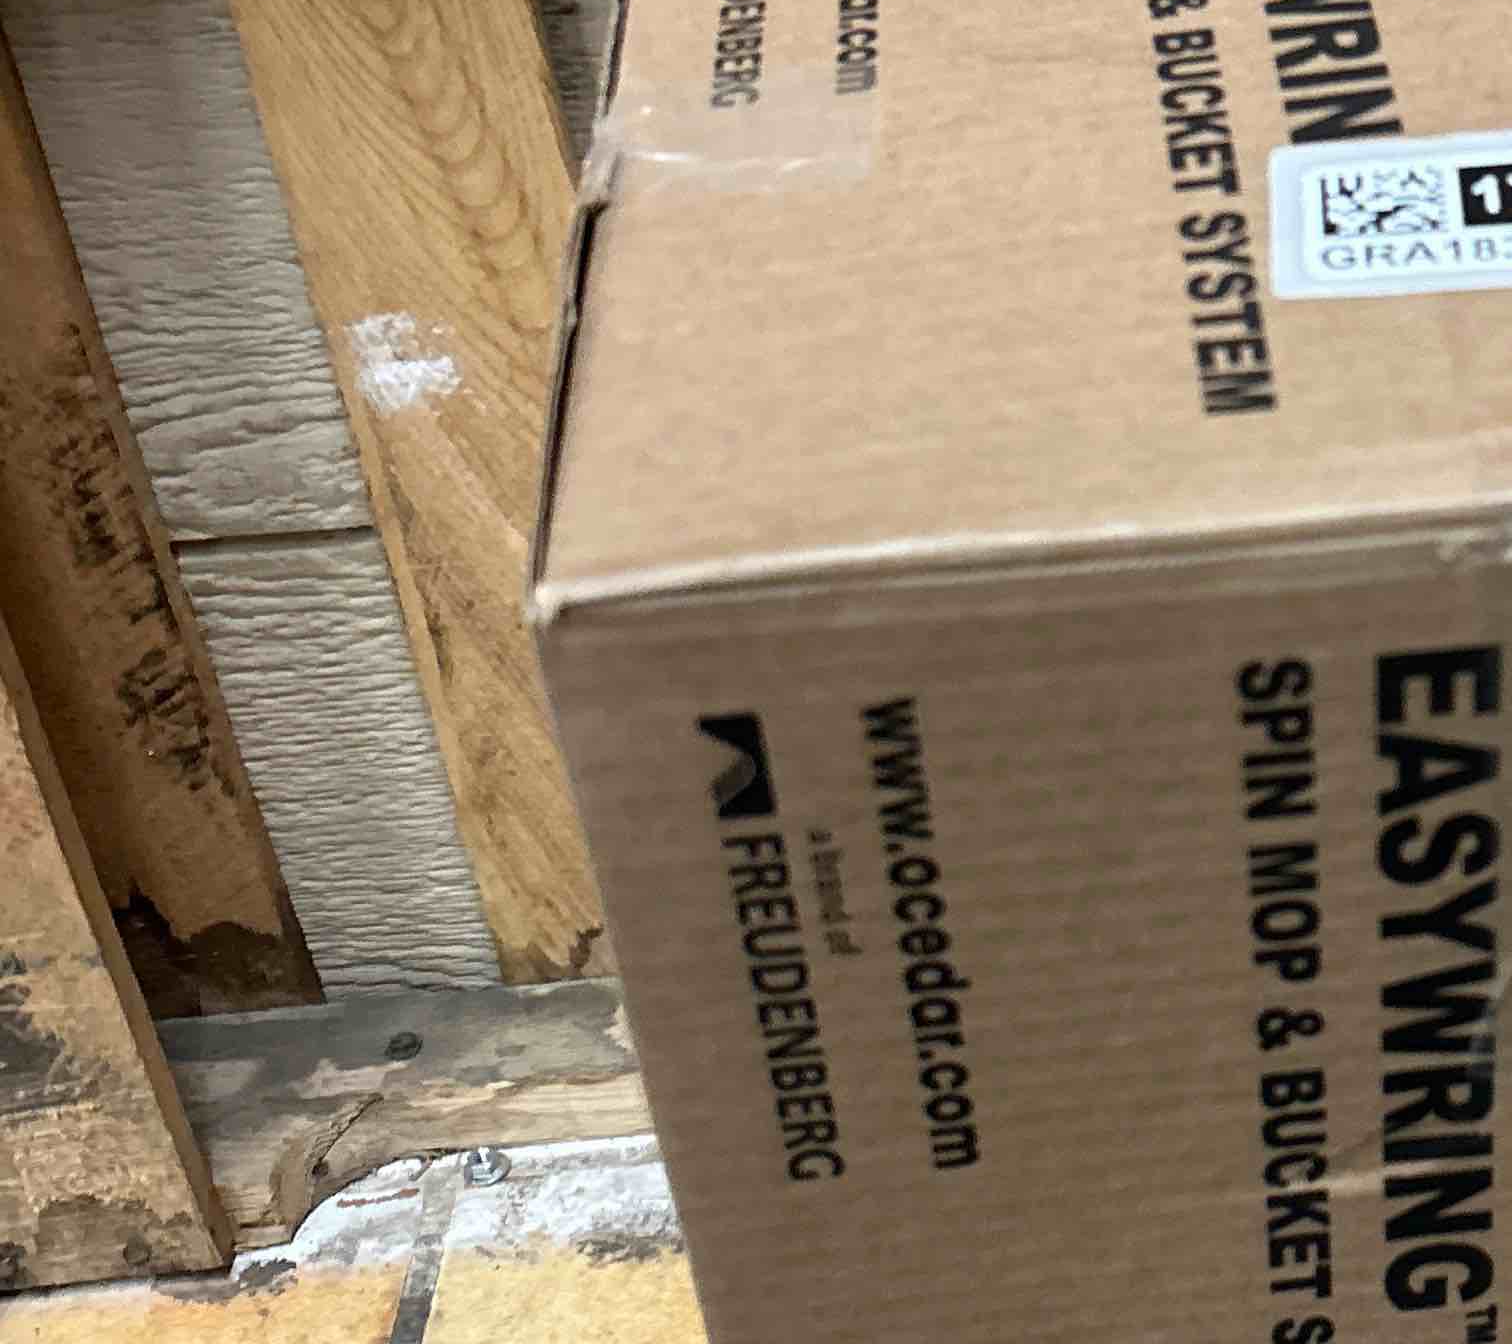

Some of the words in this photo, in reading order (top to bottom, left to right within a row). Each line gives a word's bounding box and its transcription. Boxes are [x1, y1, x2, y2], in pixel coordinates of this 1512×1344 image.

[1153, 29, 1239, 195] BUCKET
[1177, 210, 1277, 417] SYSTEM
[1236, 659, 1318, 820] SPIN
[859, 696, 981, 1170] www.ocedar.com
[1248, 842, 1321, 983] MOP
[720, 831, 846, 1182] FREUDENBERG
[1256, 1008, 1325, 1050] &
[1260, 1069, 1333, 1299] BUCKET
